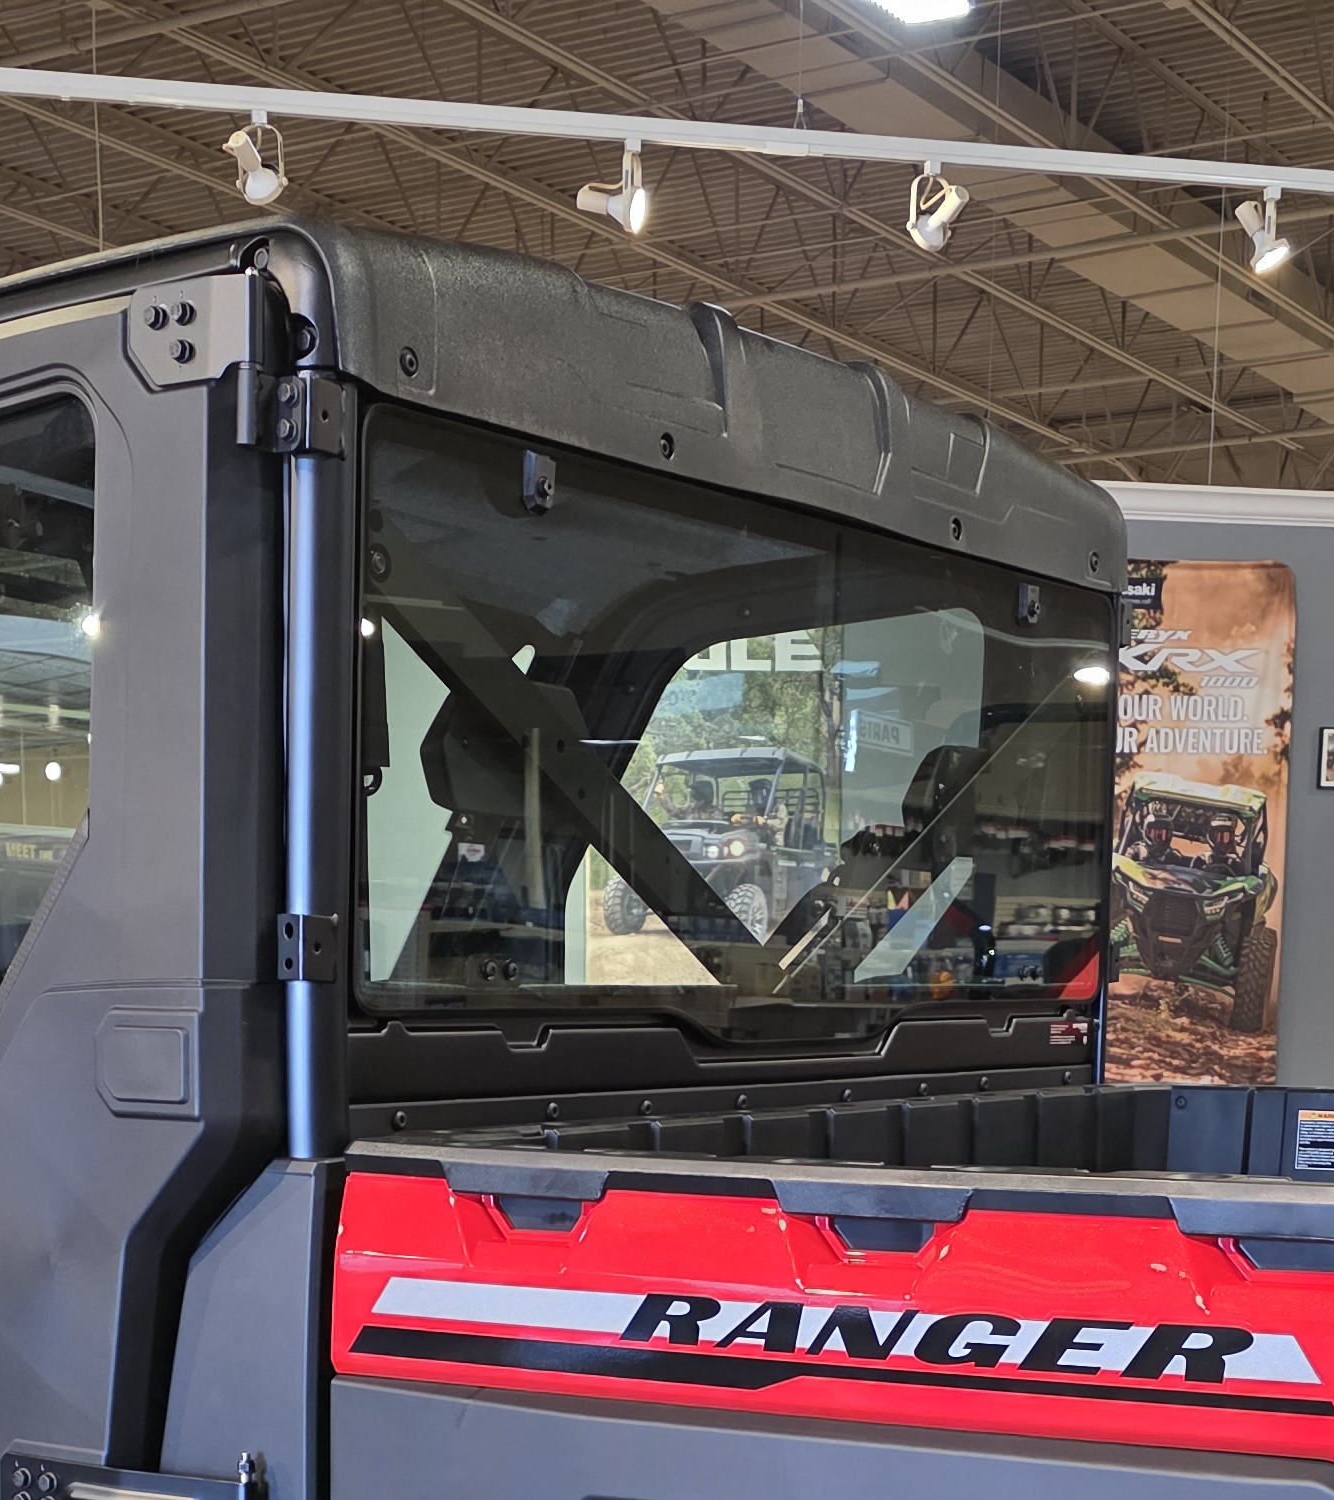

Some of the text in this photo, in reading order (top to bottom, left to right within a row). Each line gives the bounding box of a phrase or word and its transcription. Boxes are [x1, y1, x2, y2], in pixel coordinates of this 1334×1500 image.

[1122, 583, 1156, 596] saki
[1119, 643, 1261, 672] KRX
[1200, 675, 1259, 688] 1000
[1170, 694, 1248, 722] WORLD.
[1145, 728, 1267, 755] ADVENTURE.
[620, 1291, 1256, 1384] RANGER
